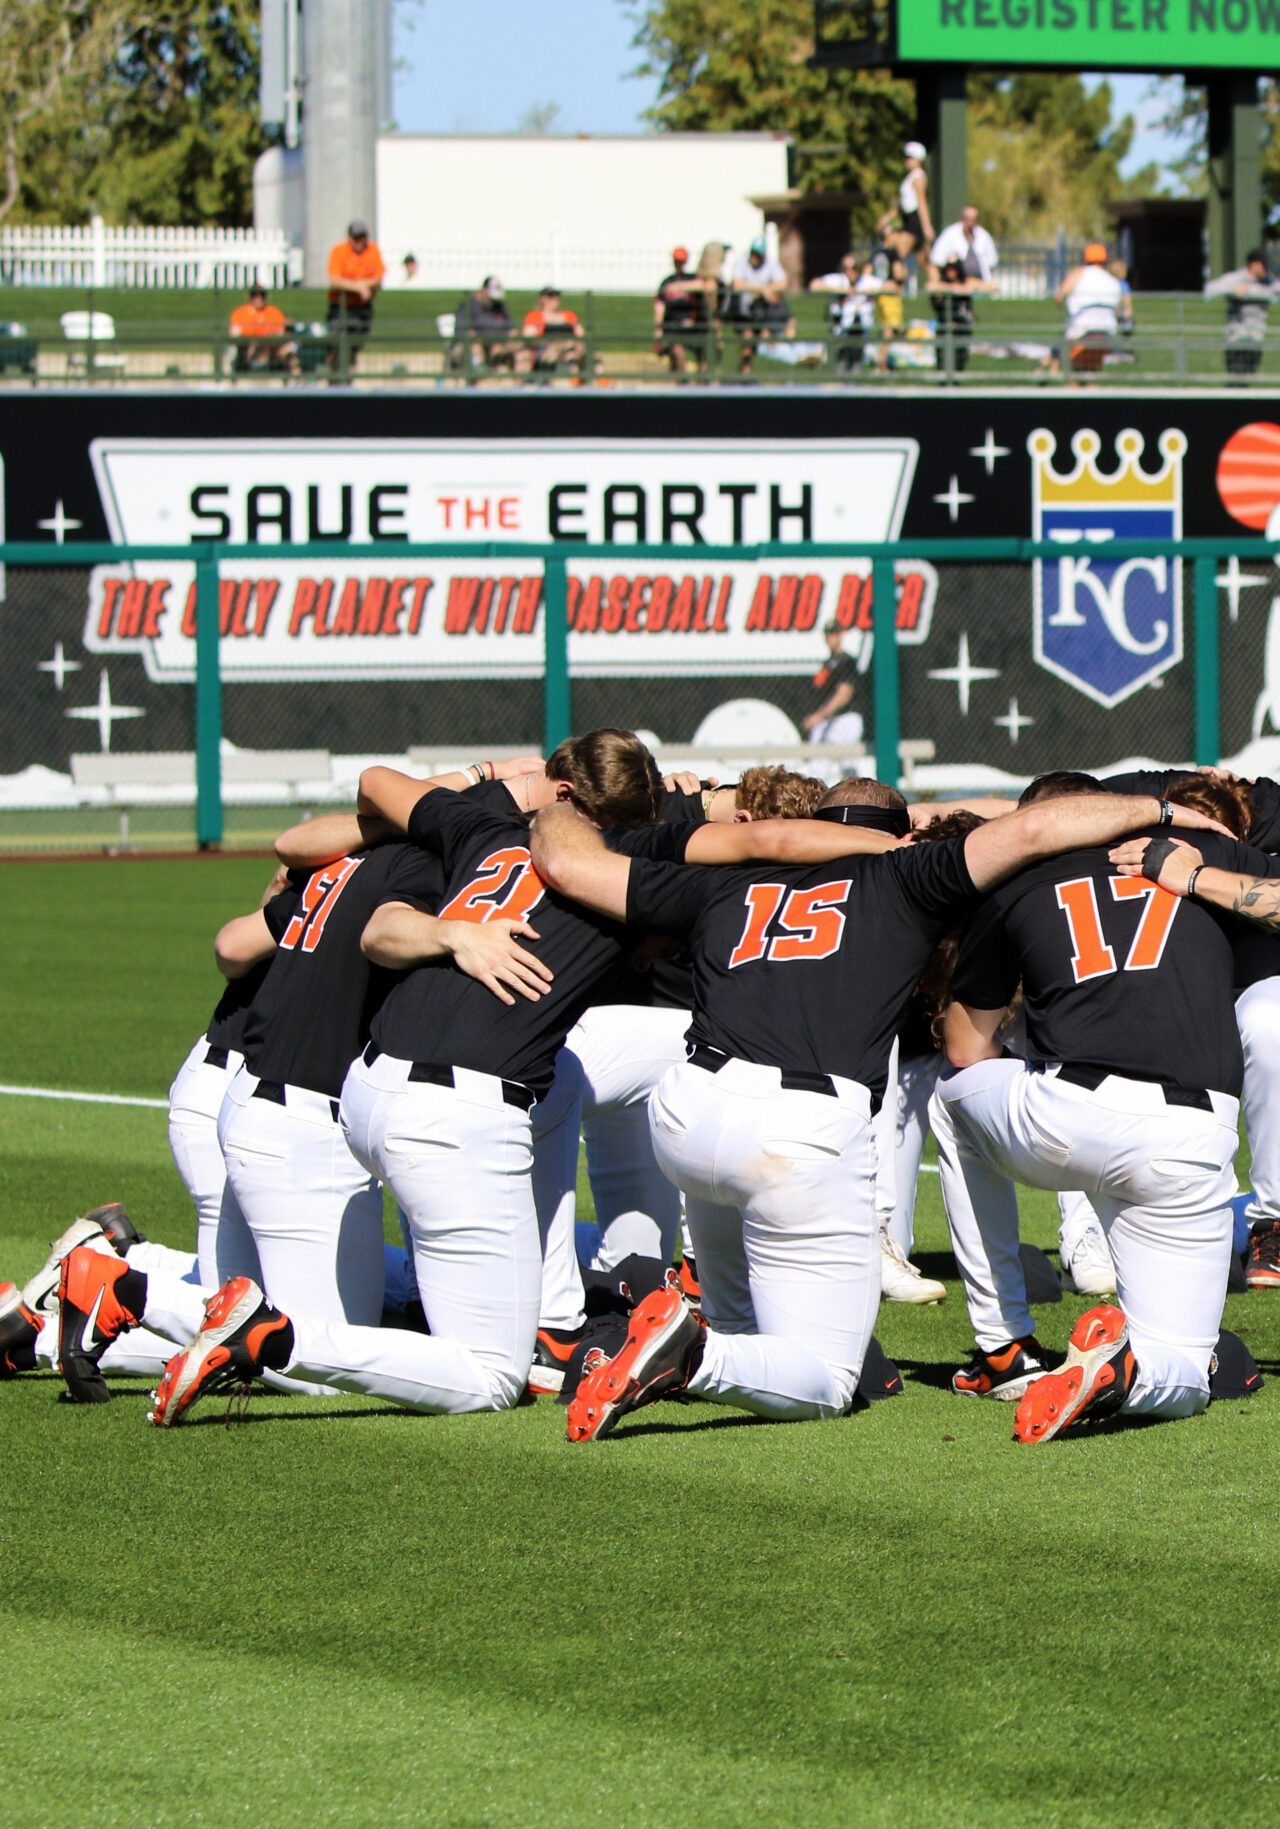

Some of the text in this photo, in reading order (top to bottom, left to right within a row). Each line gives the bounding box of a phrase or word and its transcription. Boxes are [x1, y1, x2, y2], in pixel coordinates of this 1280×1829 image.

[940, 0, 1169, 31] REGISTER
[437, 498, 521, 530] THE
[549, 484, 812, 543] EARTH
[97, 578, 171, 637] THE
[288, 577, 433, 636] PLANET
[444, 576, 545, 634] WITH
[745, 575, 823, 631] AND
[728, 879, 854, 970] 15
[1055, 875, 1182, 984] 17
